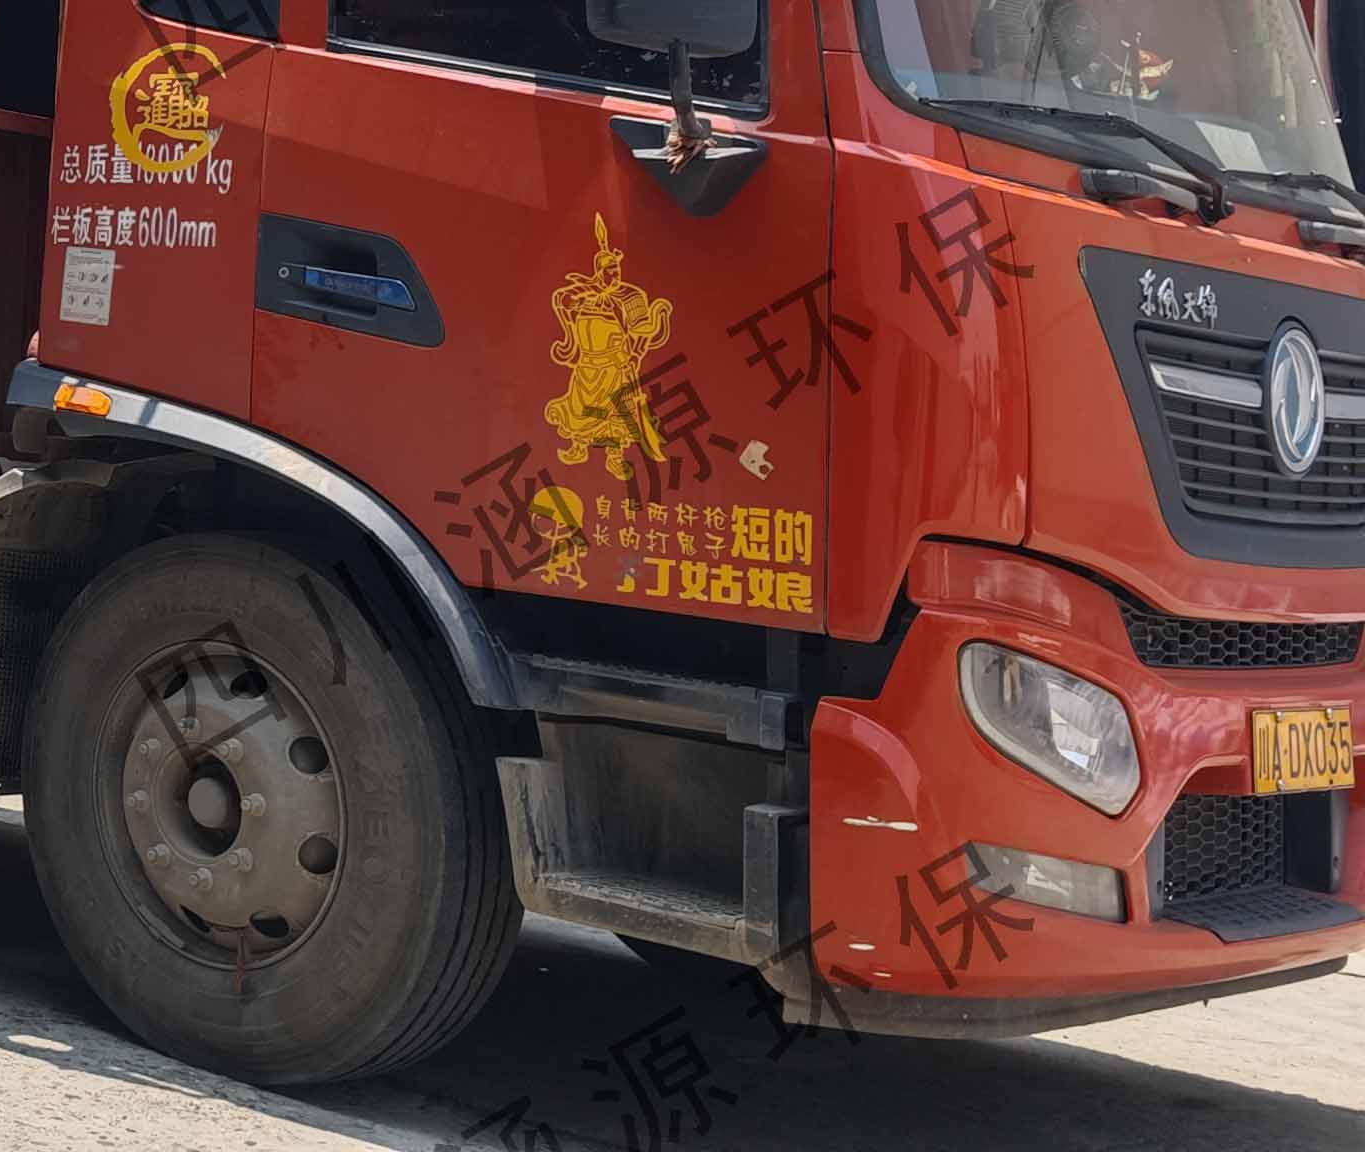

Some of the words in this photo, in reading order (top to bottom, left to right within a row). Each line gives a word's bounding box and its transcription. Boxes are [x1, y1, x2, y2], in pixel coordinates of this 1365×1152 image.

[51, 205, 217, 248] 栏板高度600mm
[595, 495, 728, 530] 身背两杆枪
[592, 524, 726, 560] 长的打鬼子
